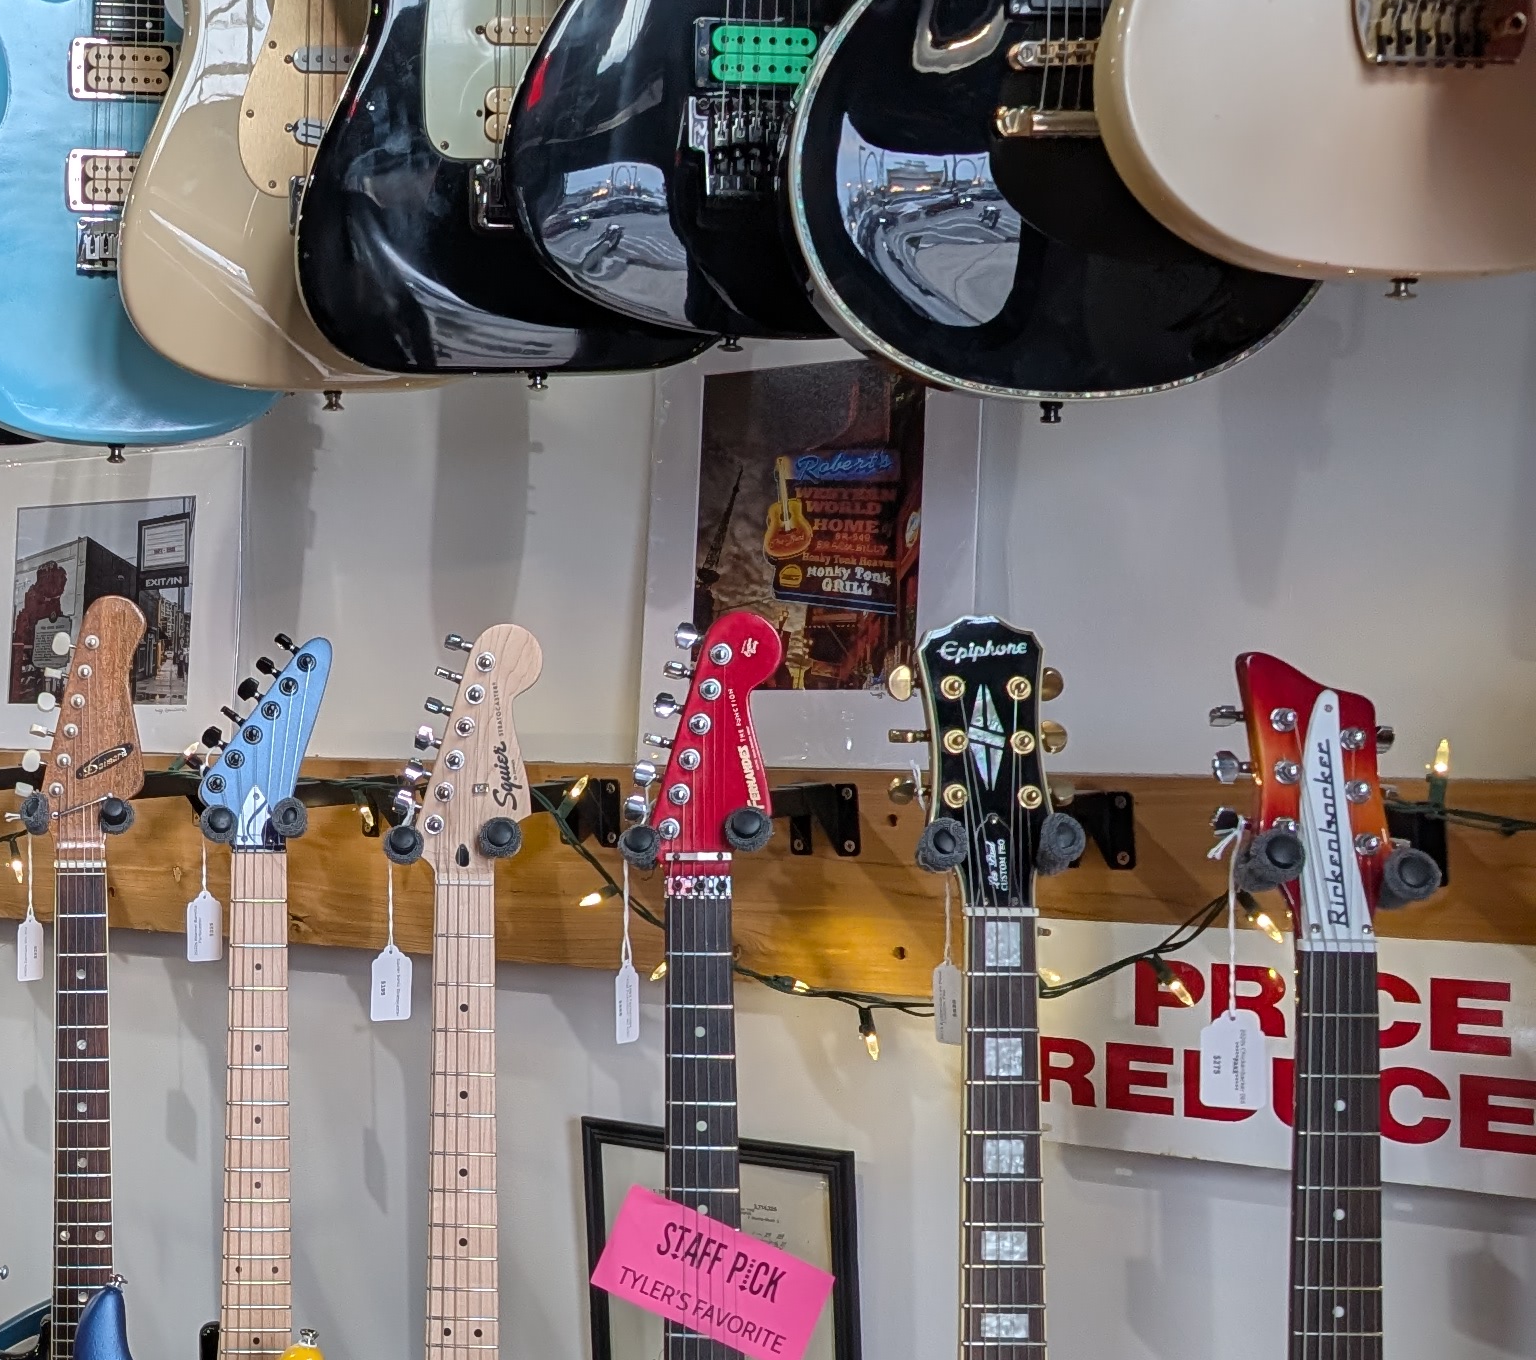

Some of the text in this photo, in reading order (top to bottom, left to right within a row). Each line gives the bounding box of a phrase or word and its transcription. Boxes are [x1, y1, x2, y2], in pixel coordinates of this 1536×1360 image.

[796, 451, 894, 482] Robert's
[807, 501, 883, 515] WORLD
[813, 518, 880, 533] HOME
[145, 576, 183, 588] EXIT/IN
[822, 578, 873, 596] GRILL
[936, 640, 1028, 664] Epiphone
[492, 682, 504, 737] STRATOCASTER
[492, 740, 523, 812] Squier
[737, 744, 765, 810] FERNANDES
[1313, 738, 1349, 929] Rickenbacker
[985, 839, 1000, 892] Les Paul
[998, 856, 1008, 892] CUSTOM
[1134, 959, 1512, 1057] PRCE
[1212, 1055, 1222, 1075] $275
[656, 1221, 788, 1305] STAFF PICK
[617, 1265, 788, 1356] TYLER'S FAVORITE
